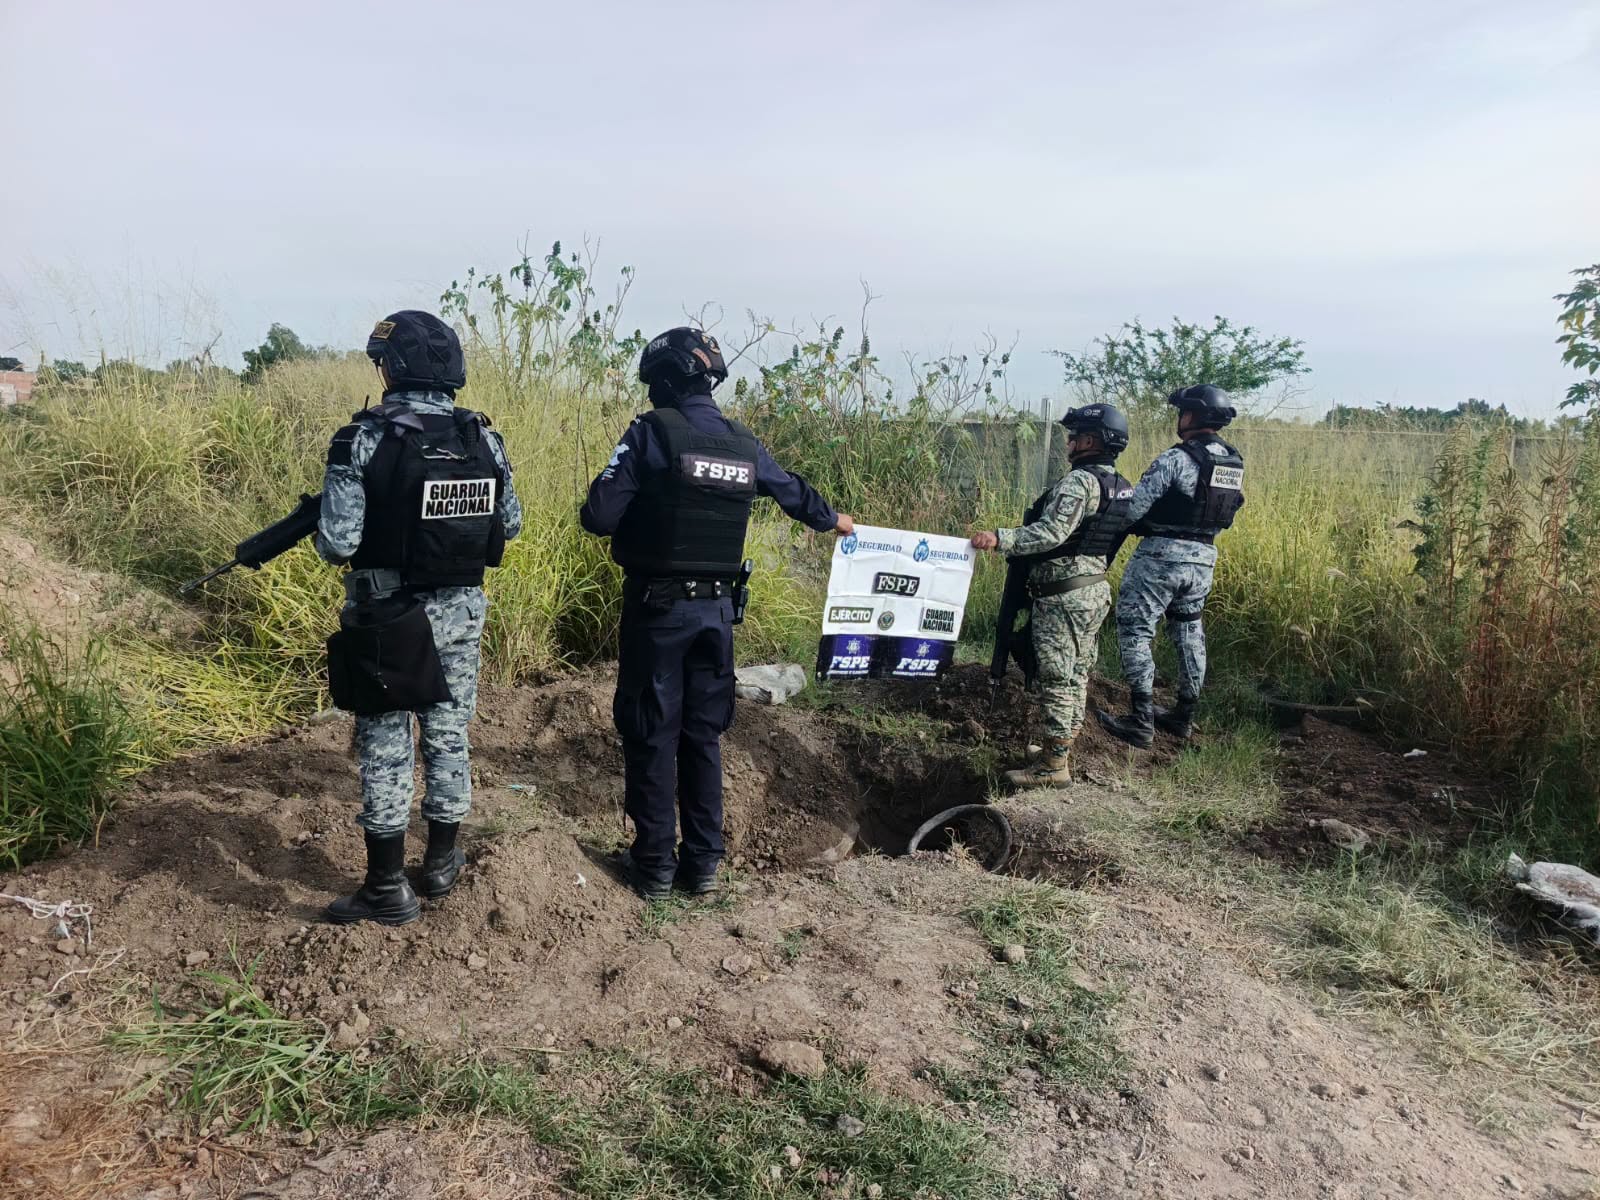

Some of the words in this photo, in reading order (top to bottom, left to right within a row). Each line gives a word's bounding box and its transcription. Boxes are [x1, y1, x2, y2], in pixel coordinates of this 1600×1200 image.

[693, 461, 749, 484] FSPE
[430, 482, 490, 500] GUARDIA
[425, 497, 491, 517] NACIONAL
[858, 541, 902, 553] SEGURIDAD
[929, 550, 969, 561] SEGURIDAD
[877, 575, 918, 594] FSPE
[925, 608, 955, 621] GUARDIA
[922, 619, 954, 633] NACIONAL
[830, 656, 871, 669] FSPE
[896, 658, 939, 671] FSPE
